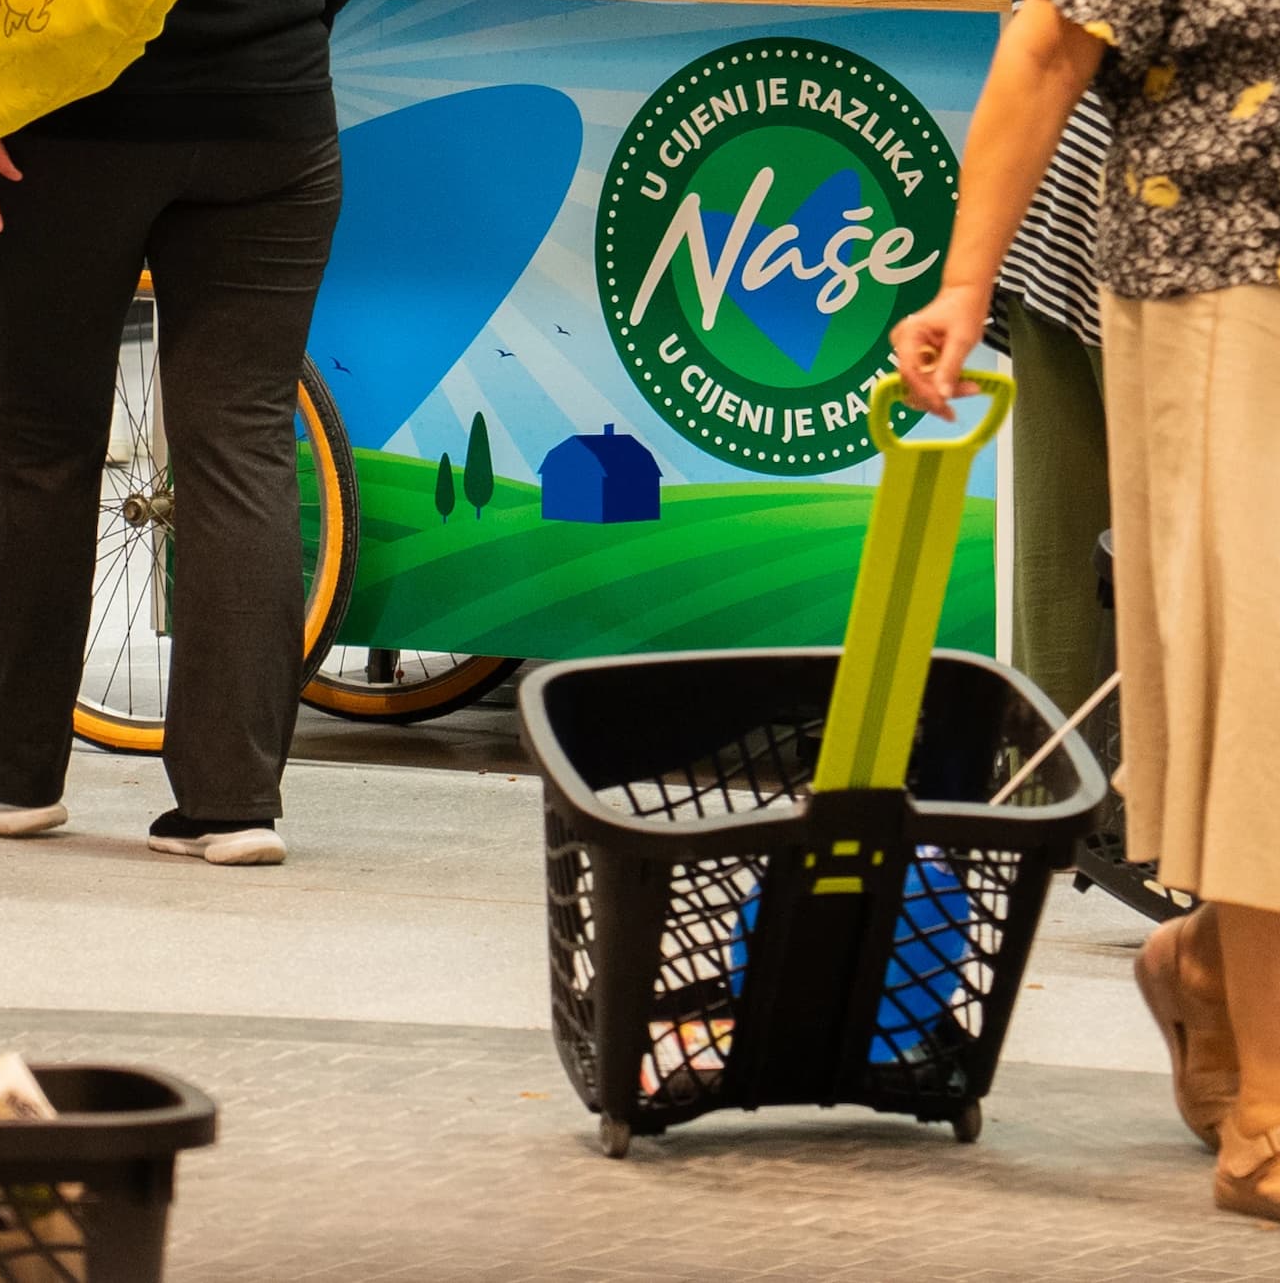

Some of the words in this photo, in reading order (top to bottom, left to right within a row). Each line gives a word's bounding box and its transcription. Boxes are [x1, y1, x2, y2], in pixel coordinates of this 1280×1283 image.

[639, 170, 668, 201] U
[658, 84, 749, 169] CIJENI
[756, 77, 788, 114] JE
[797, 79, 925, 198] RAZLIKA
[630, 166, 941, 330] Naše
[658, 332, 687, 364] U
[680, 364, 774, 436] CIJENI
[780, 408, 816, 444] JE
